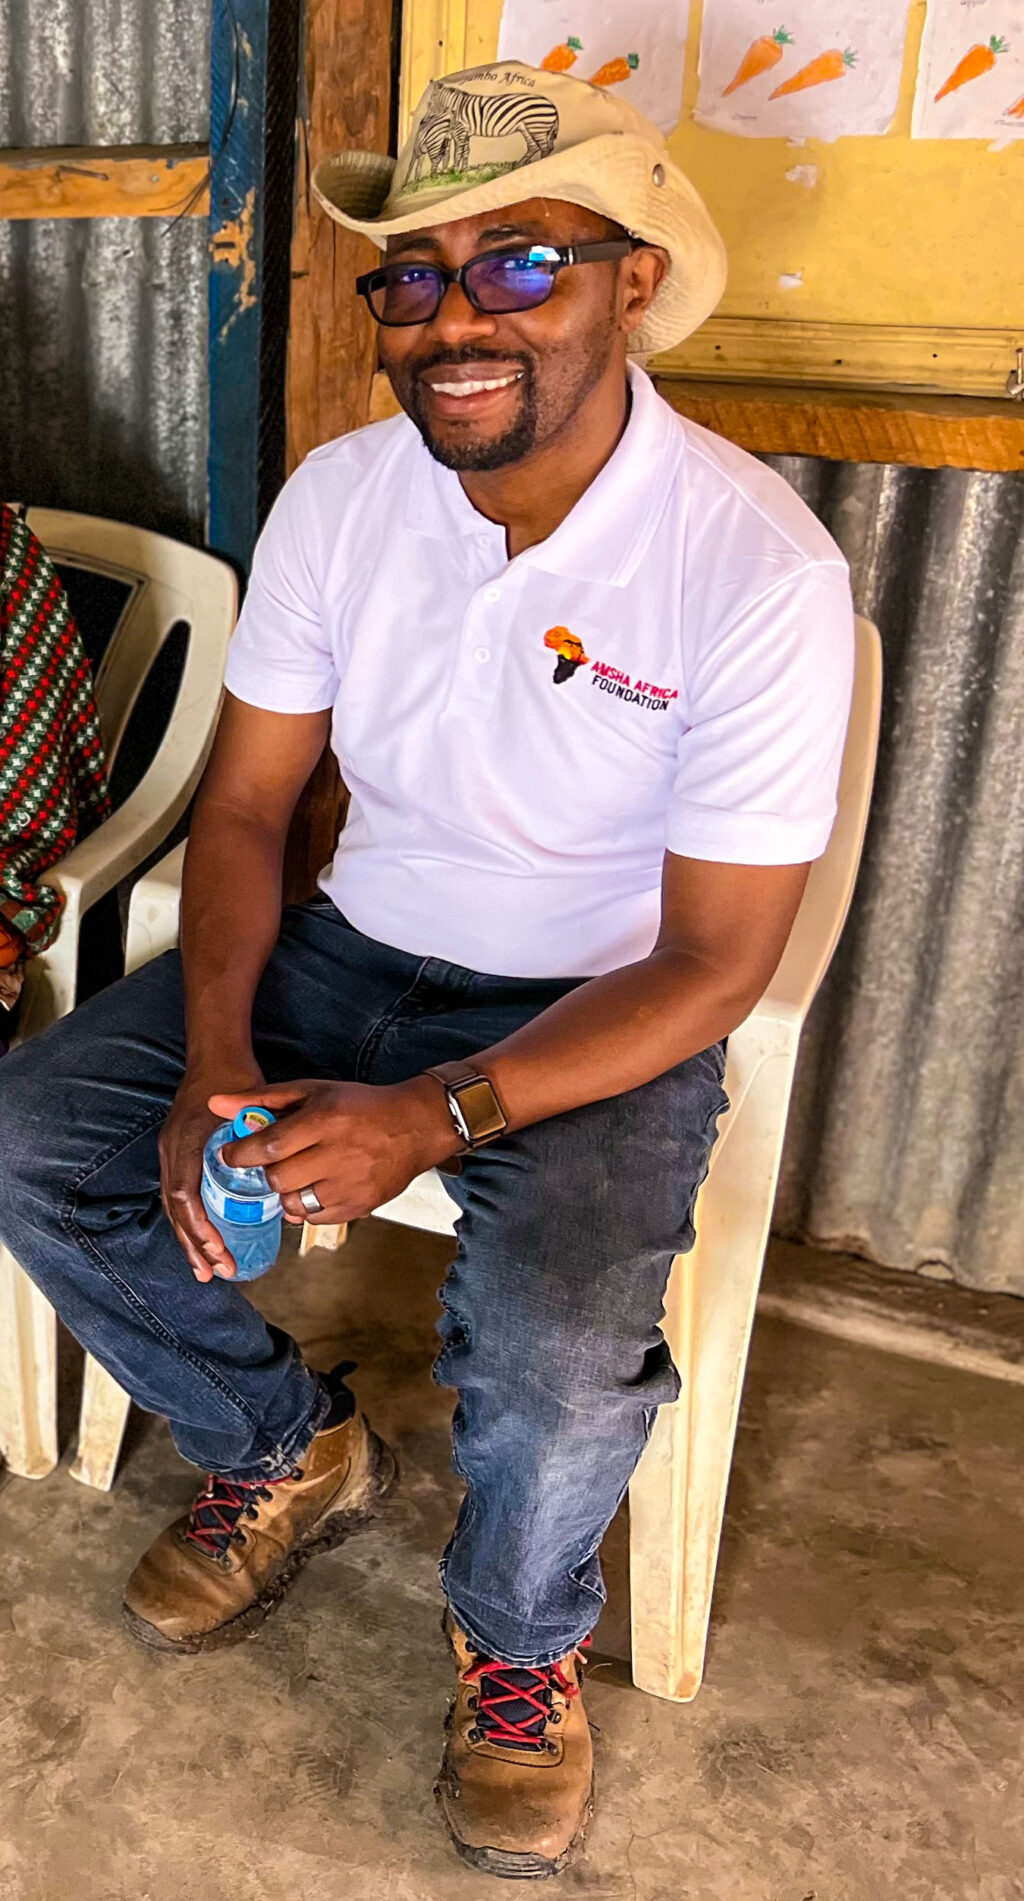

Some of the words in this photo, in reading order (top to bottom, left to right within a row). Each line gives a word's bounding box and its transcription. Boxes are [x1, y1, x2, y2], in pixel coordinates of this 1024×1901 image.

[499, 72, 536, 88] Africa
[590, 661, 631, 687] AMSHA
[633, 679, 679, 700] AFRICA
[591, 675, 670, 711] FOUNDATION
